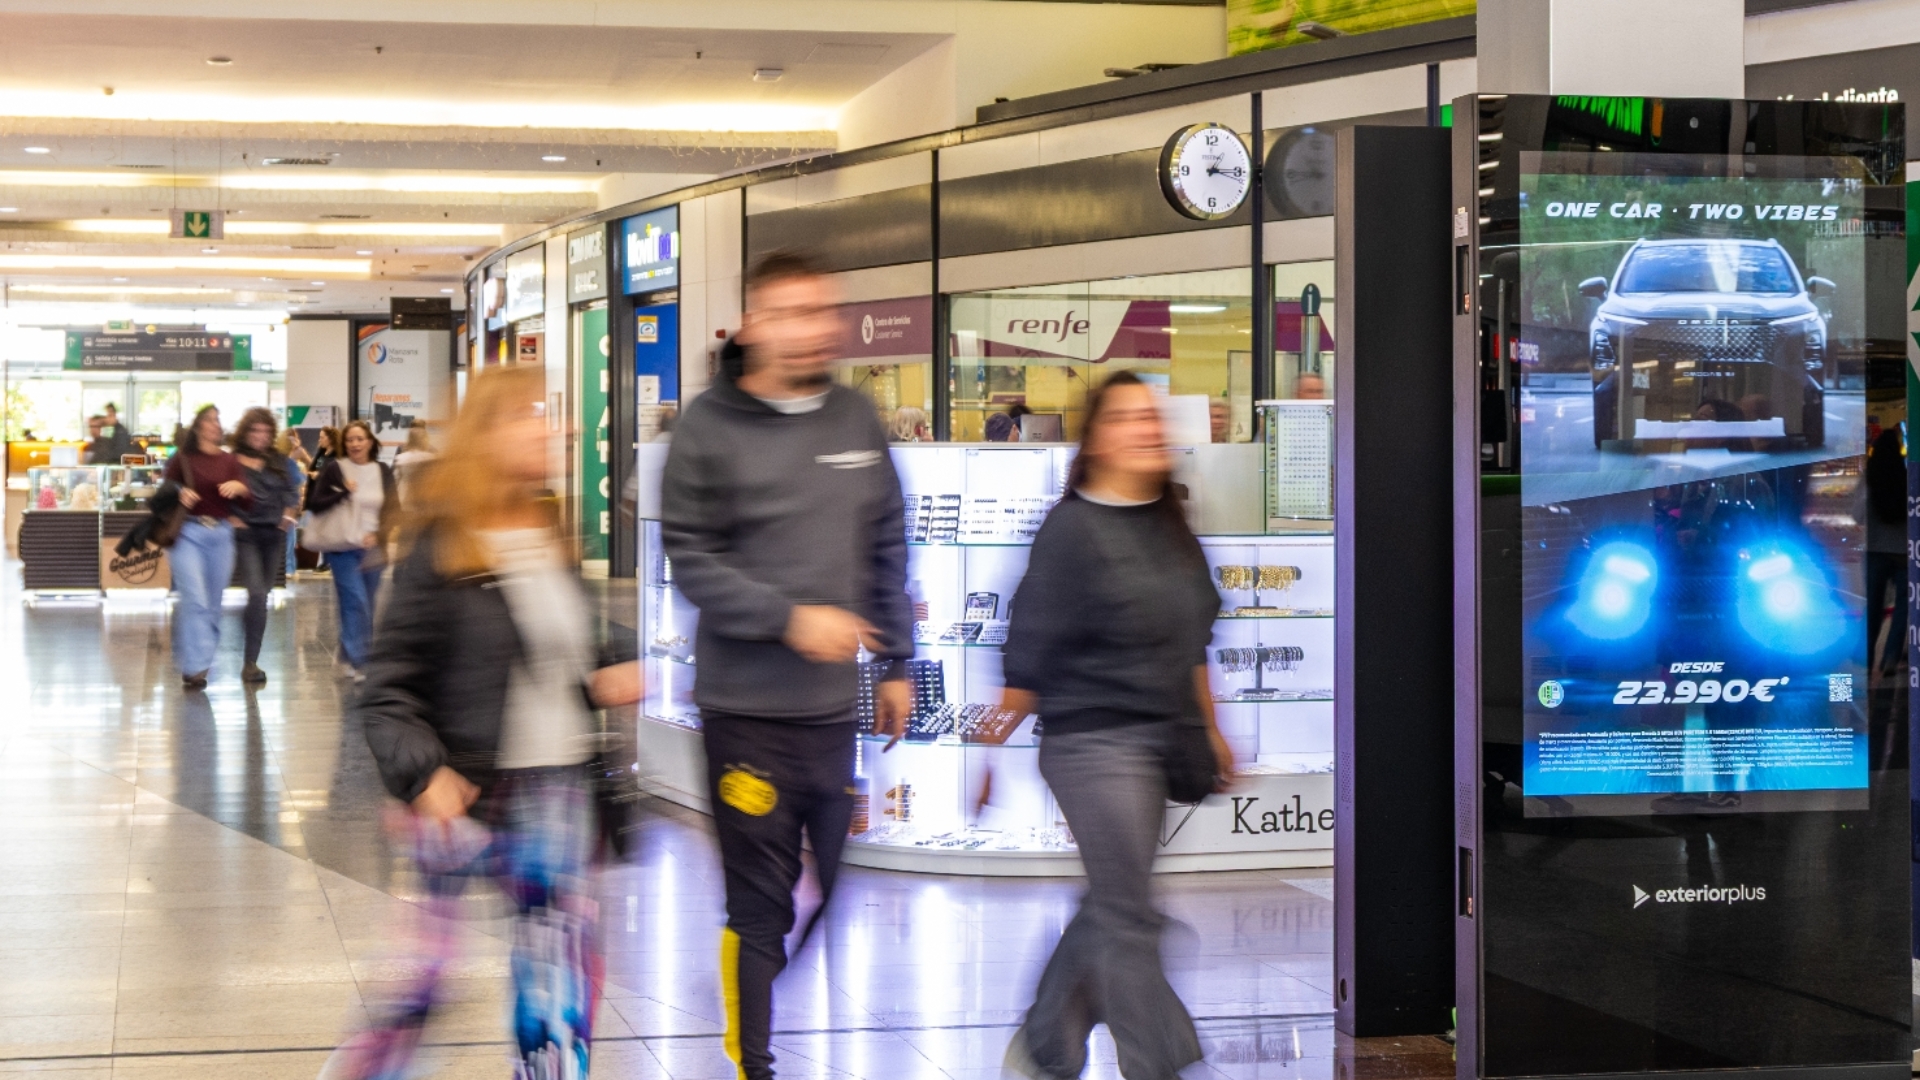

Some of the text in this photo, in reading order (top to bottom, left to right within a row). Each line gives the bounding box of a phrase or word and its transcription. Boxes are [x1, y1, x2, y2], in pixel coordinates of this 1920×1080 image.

[1205, 135, 1218, 146] 12
[1181, 165, 1190, 176] 9
[1233, 166, 1242, 177] 3
[1207, 197, 1217, 208] 6
[1545, 202, 1600, 217] ONE
[1609, 202, 1663, 218] CAR
[1689, 203, 1743, 219] TWO
[1754, 205, 1839, 221] VIBES
[1007, 310, 1091, 343] renfe
[1669, 661, 1725, 674] DESDE
[1231, 795, 1335, 834] Kathe
[1655, 883, 1767, 905] exteriorplus
